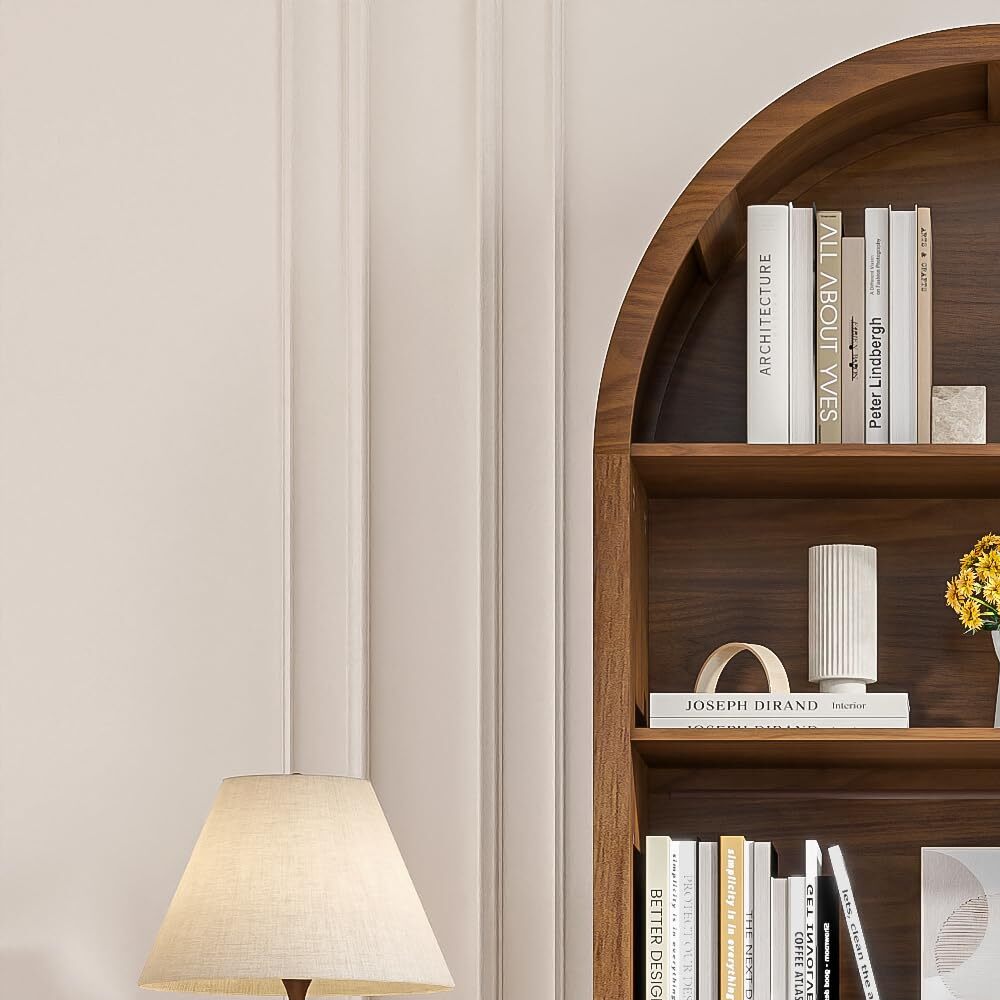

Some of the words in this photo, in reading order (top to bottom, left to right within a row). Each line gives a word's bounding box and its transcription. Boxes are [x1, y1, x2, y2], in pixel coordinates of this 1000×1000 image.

[819, 222, 838, 264] ALL
[759, 253, 772, 376] ARCHITECTURE
[819, 271, 838, 353] ABOUT
[869, 317, 886, 388] Lindbergh
[819, 363, 838, 422] YVES
[869, 393, 882, 429] Peter
[685, 700, 748, 711] JOSEPH
[755, 700, 819, 711] DIRAND
[832, 701, 867, 710] Interior
[726, 848, 737, 907] simplicity
[650, 888, 663, 946] BETTER
[728, 910, 736, 920] is
[728, 923, 736, 934] in
[745, 910, 753, 939] THE
[842, 888, 853, 920] lets,
[850, 923, 864, 962] clean
[861, 964, 872, 989] the
[726, 939, 736, 1000] everything
[745, 944, 753, 983] NEXT
[794, 931, 804, 967] COFFEE
